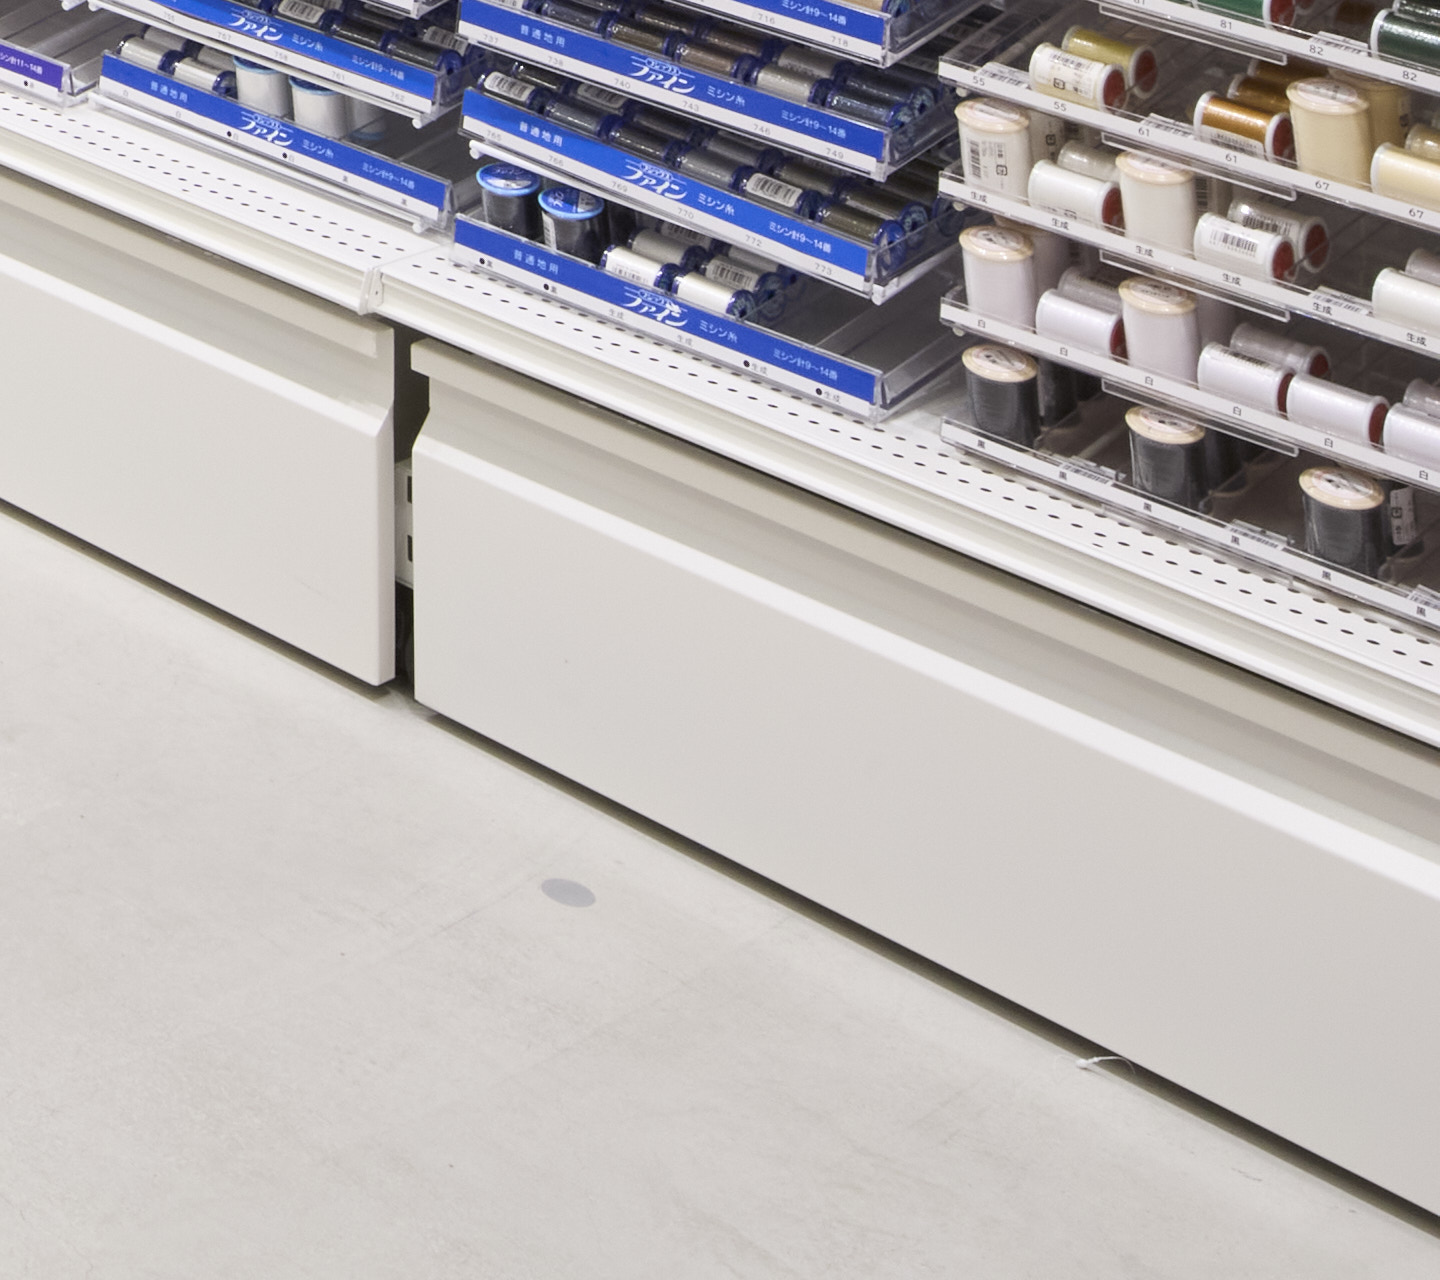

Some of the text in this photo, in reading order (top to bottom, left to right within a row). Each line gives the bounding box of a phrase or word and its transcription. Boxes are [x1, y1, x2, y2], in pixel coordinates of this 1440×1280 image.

[1309, 44, 1324, 56] 82
[1409, 207, 1425, 218] 67
[1053, 218, 1068, 230] 生成
[1146, 375, 1155, 386] 白
[1231, 534, 1241, 546] 黒
